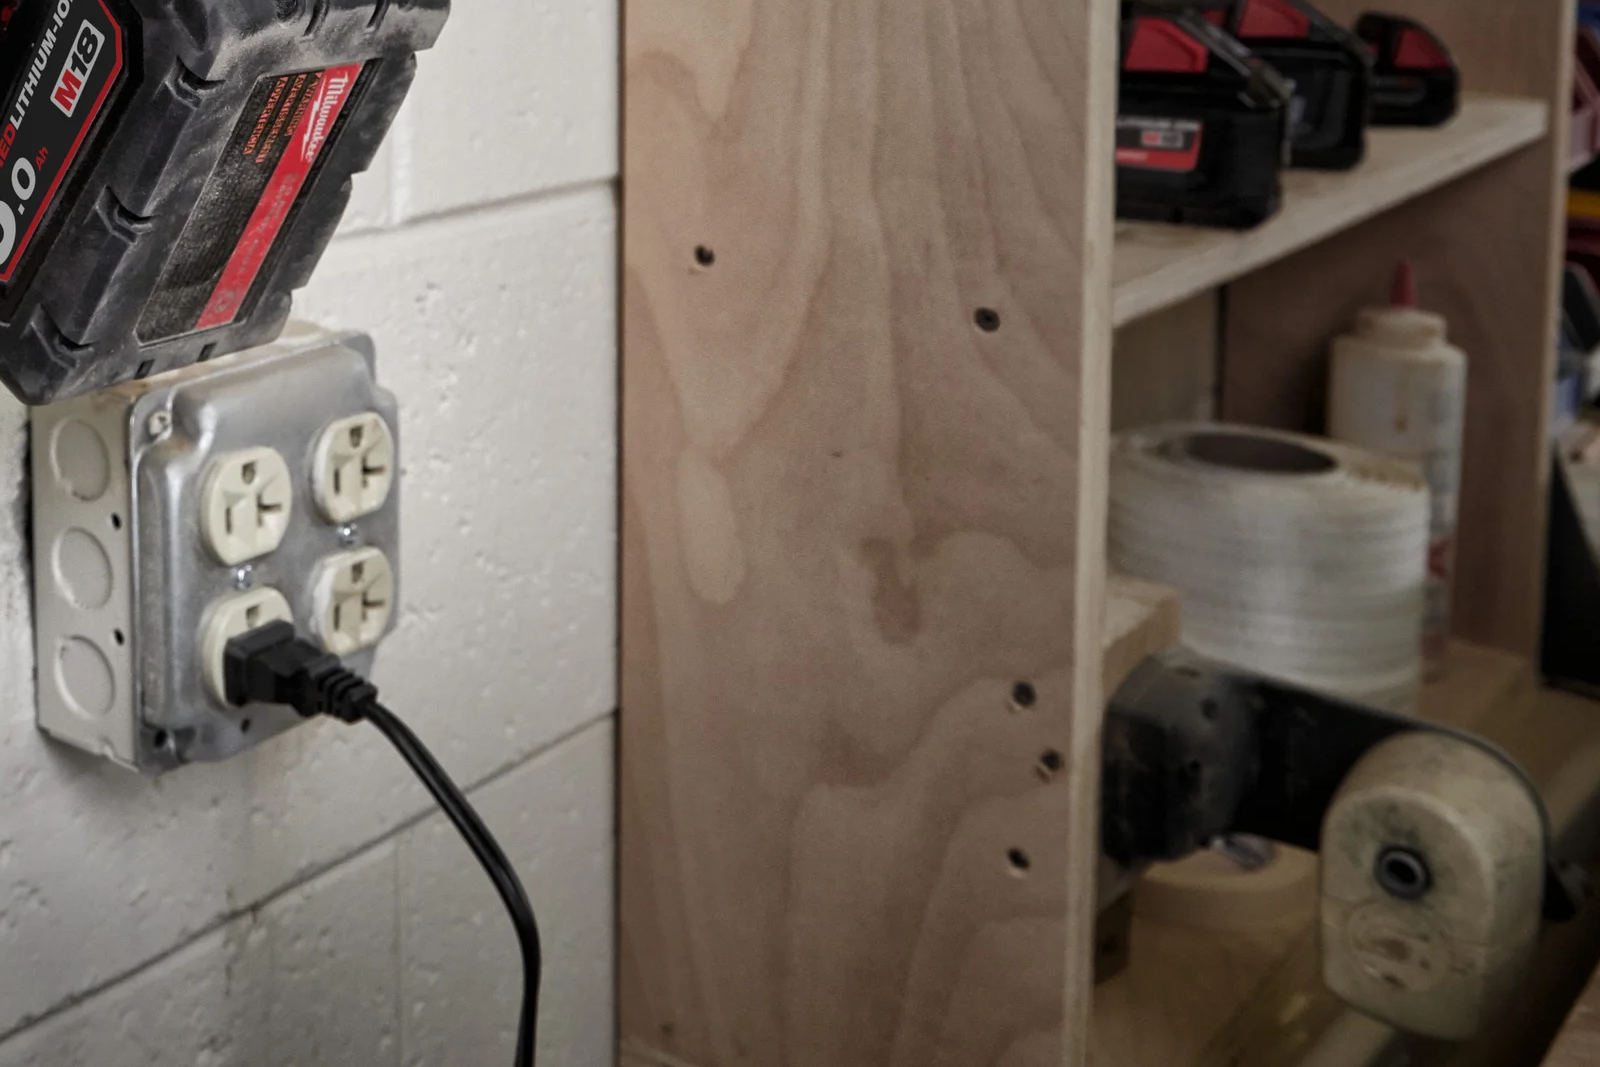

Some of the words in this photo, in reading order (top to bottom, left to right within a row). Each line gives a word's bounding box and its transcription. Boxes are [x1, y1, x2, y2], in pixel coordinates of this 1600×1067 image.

[54, 25, 99, 112] M18
[306, 70, 348, 159] Milwaukee
[36, 146, 49, 171] Ah
